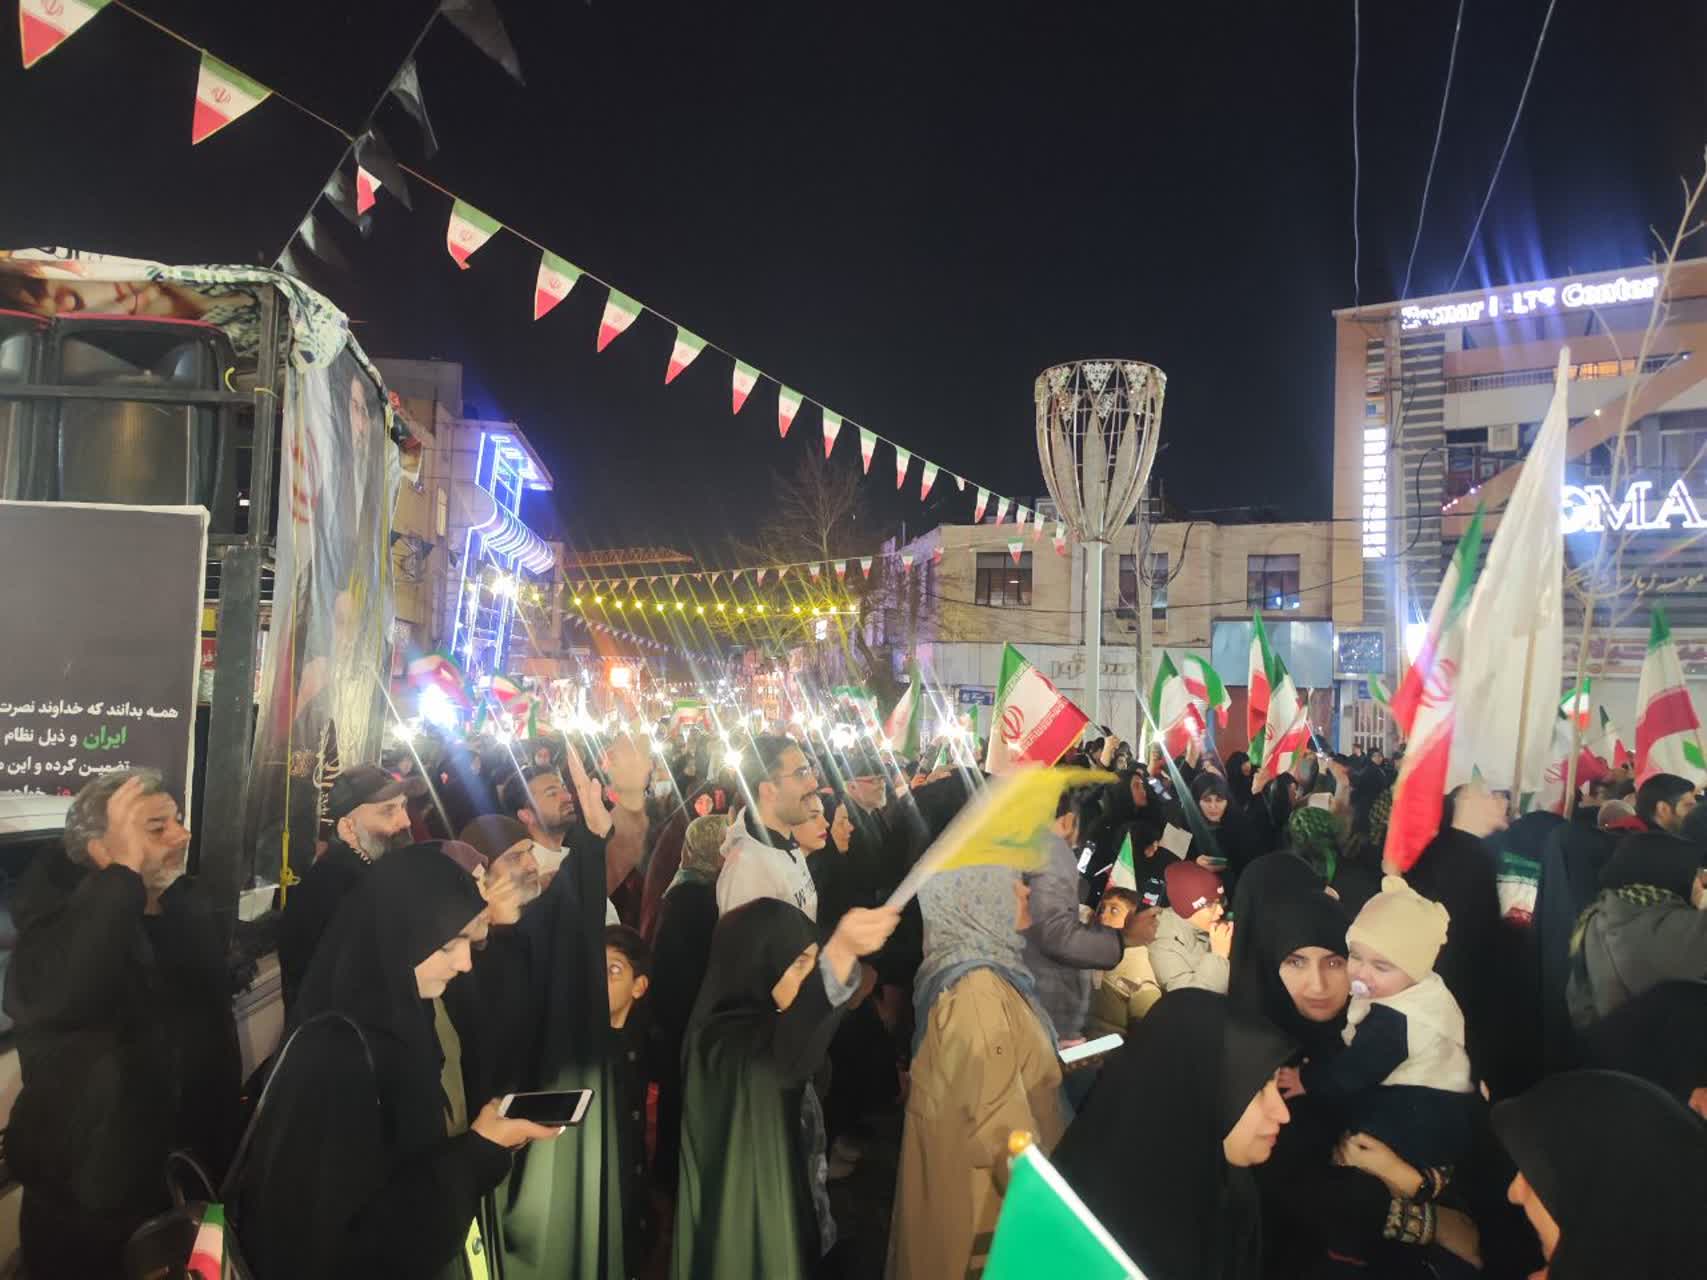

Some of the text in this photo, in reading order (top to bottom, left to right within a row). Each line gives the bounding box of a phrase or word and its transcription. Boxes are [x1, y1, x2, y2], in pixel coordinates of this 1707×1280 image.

[0, 699, 179, 720] همه بدانند که خداوند نصرت
[4, 725, 128, 750] ایران و ذیل نظام
[7, 755, 32, 774] این
[33, 762, 42, 775] و
[45, 758, 76, 775] کرده
